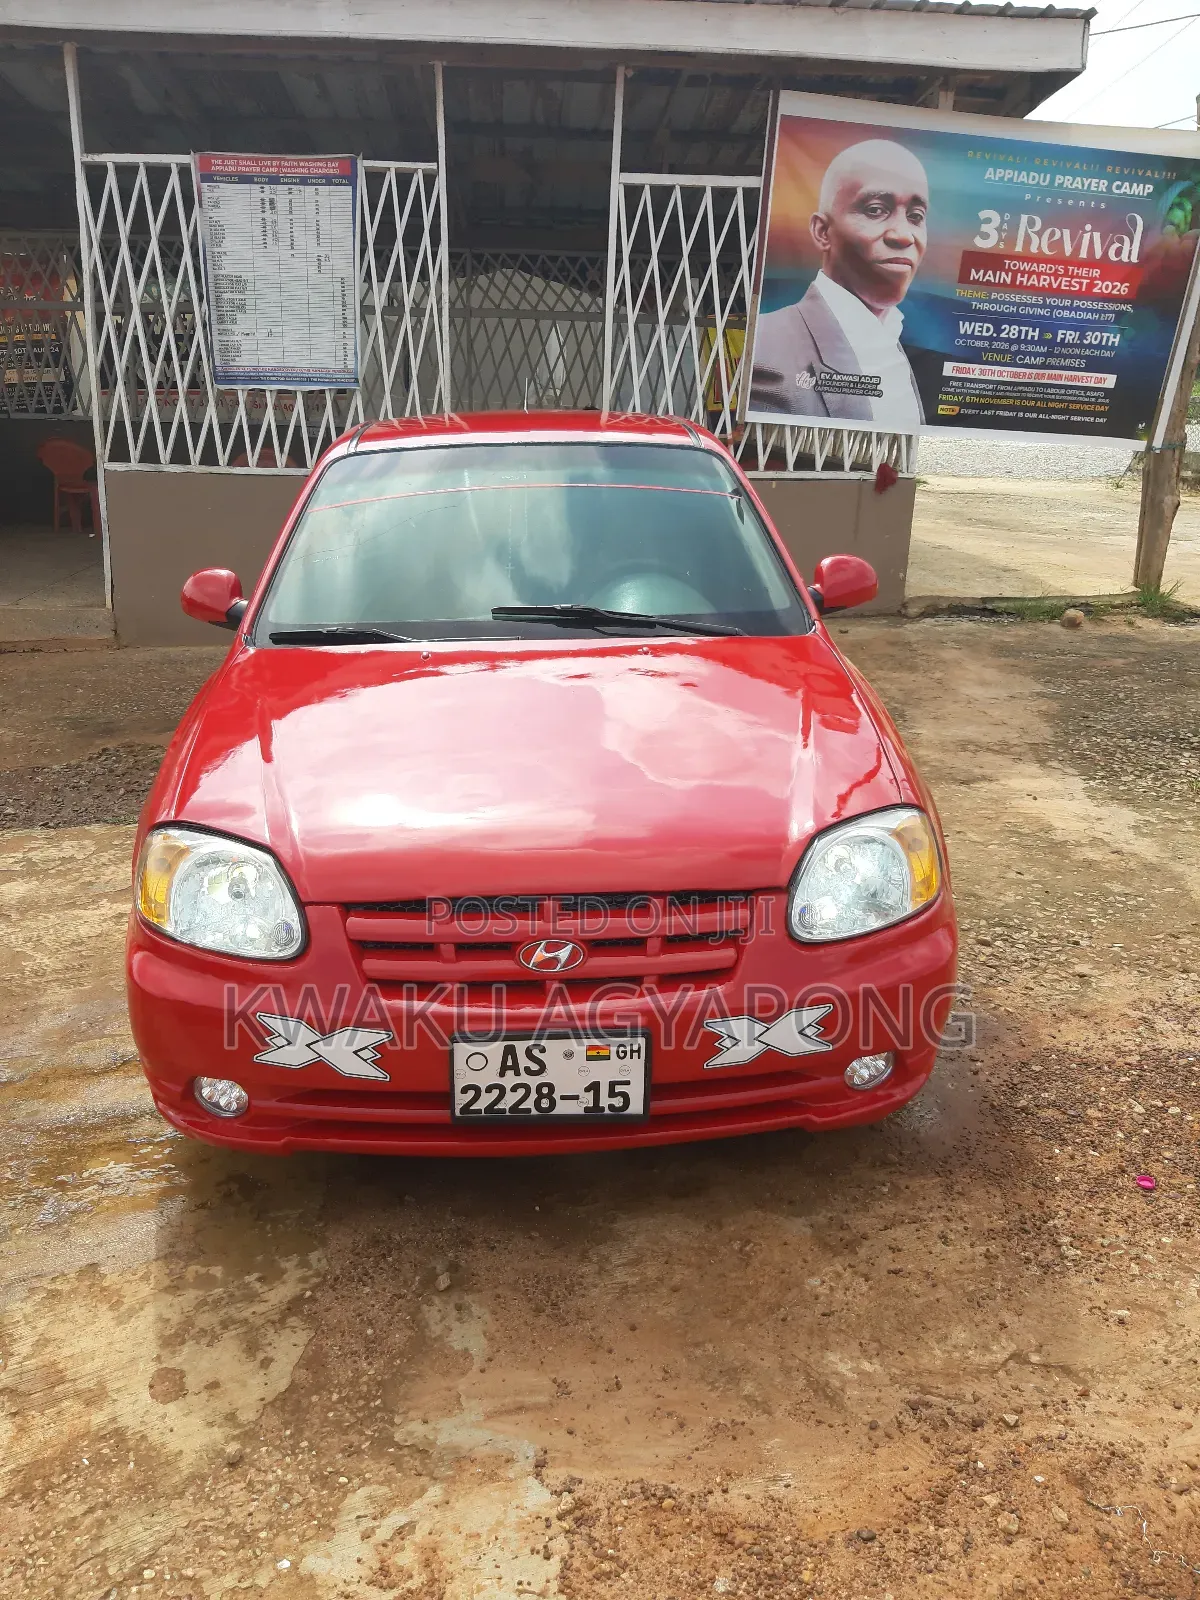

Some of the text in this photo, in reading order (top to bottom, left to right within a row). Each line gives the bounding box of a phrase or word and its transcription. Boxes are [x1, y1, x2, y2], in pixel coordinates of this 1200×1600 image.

[968, 150, 1176, 180] REVIVAL! REVIVAL!! REVIVAL!!!
[984, 168, 1154, 196] APPIADU PRAYER CAMP
[1025, 194, 1106, 208] presents
[974, 210, 1144, 264] 3 Revival
[999, 213, 1010, 248] DAYS
[1004, 260, 1100, 278] TOWARD'S THEIR
[970, 269, 1130, 295] MAIN HARVEST 2026
[956, 289, 1134, 313] THEME: POSSESSES YOUR POSSESSIONS,
[972, 302, 1016, 313] THROUGH
[1019, 306, 1050, 316] GIVING
[1053, 308, 1099, 320] (OBADIAH
[955, 339, 990, 349] OCTOBER,
[992, 342, 1009, 350] 2026
[1020, 344, 1047, 352] 9:30AM
[959, 321, 1120, 346] WED. 28TH FRI. 30TH
[982, 352, 1086, 368] VENUE: CAMP PREMISES
[952, 366, 976, 376] FRIDAY,
[978, 368, 995, 377] 30TH
[997, 370, 1027, 379] OCTOBER
[1064, 374, 1094, 384] HARVEST
[964, 382, 997, 390] TRANSPORT
[938, 394, 964, 402] FRIDAY,
[499, 1043, 642, 1077] AS GH
[459, 1080, 631, 1115] 2228-15
